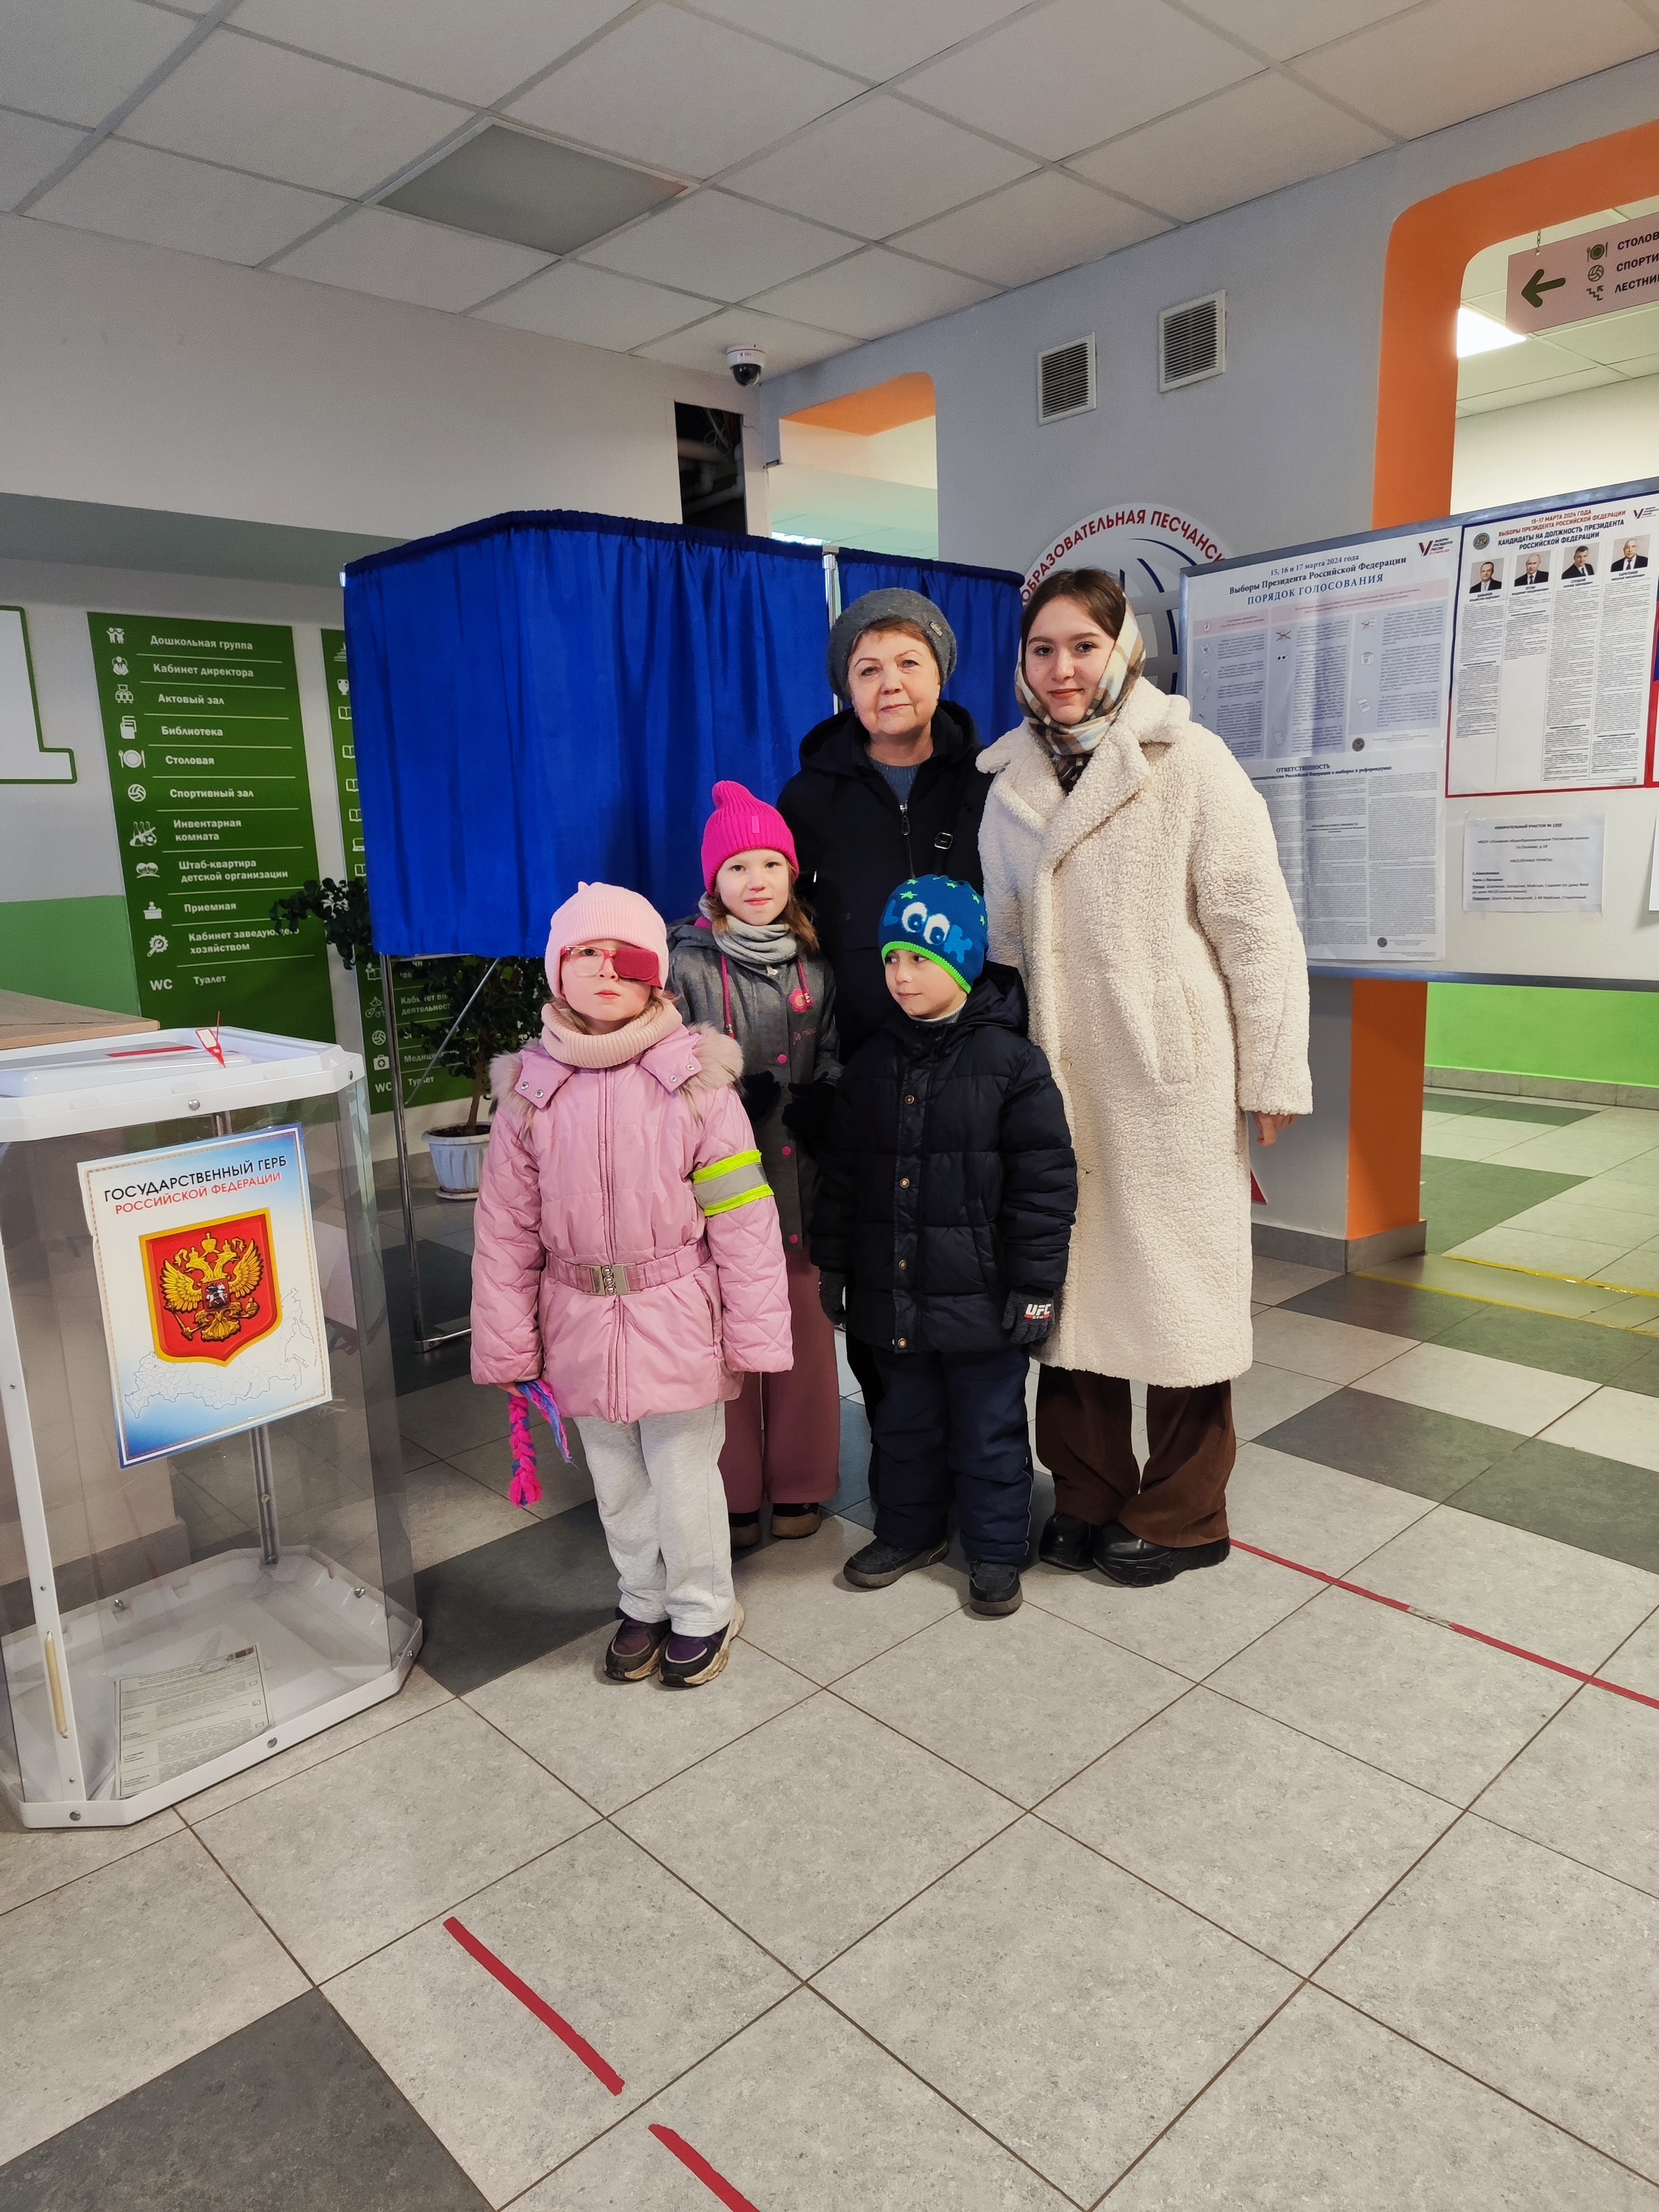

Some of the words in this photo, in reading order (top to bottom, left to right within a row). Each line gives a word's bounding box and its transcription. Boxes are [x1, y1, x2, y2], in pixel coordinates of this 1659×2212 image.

[1615, 273, 1659, 293] ЛЕСТНИ
[1499, 528, 1521, 537] ВЫБОРЫ
[1521, 522, 1555, 533] ПРЕЗИДЕНТА
[1556, 516, 1591, 527] РОССИЙСКОЙ
[1593, 510, 1626, 521] ФЕДЕРАЦИИ
[1545, 514, 1562, 522] МАРТА
[1498, 534, 1534, 546] КАНДИДАТЫ
[1545, 526, 1583, 538] ДОЛЖНОСТЬ
[1584, 519, 1624, 531] ПРЕЗИДЕНТА
[1519, 537, 1560, 550] РОССИЙСКОЙ
[1561, 531, 1600, 544] ФЕДЕРАЦИИ
[1305, 561, 1325, 570] марта
[1326, 557, 1342, 566] 2024
[1344, 555, 1359, 564] года
[1229, 583, 1259, 595] Выборы
[1262, 574, 1306, 589] Президента
[1309, 565, 1356, 580] Российской
[1358, 557, 1407, 571] Федерации
[1247, 588, 1295, 605] ПОРЯДОК
[1299, 574, 1384, 596] ГОЛОСОВАНИЯ
[151, 636, 216, 647] Дошкольная
[219, 642, 252, 650] группа
[153, 664, 198, 673] Кабинет
[201, 668, 253, 678] директора
[159, 694, 204, 704] Актовый
[161, 726, 223, 736] Библиотека
[166, 756, 214, 764] Столовая
[170, 789, 234, 799] Спортивный
[174, 820, 241, 828] Инвентарная
[179, 860, 257, 871] Штаб-квартира
[181, 872, 222, 882] детской
[225, 871, 288, 881] организации
[184, 903, 236, 913] Приемная
[189, 932, 231, 941] Кабинет
[191, 944, 249, 954] хозяйством
[150, 979, 172, 990] WC
[193, 976, 226, 986] Туалет
[375, 1082, 392, 1093] WC
[104, 1159, 254, 1203] ГОСУДАРСТВЕННЫЙ
[258, 1155, 287, 1172] ГЕРБ
[115, 1185, 208, 1215] РОССИЙСКОЙ
[211, 1172, 281, 1195] ФЕДЕРАЦИИ
[1026, 1304, 1051, 1316] UFC
